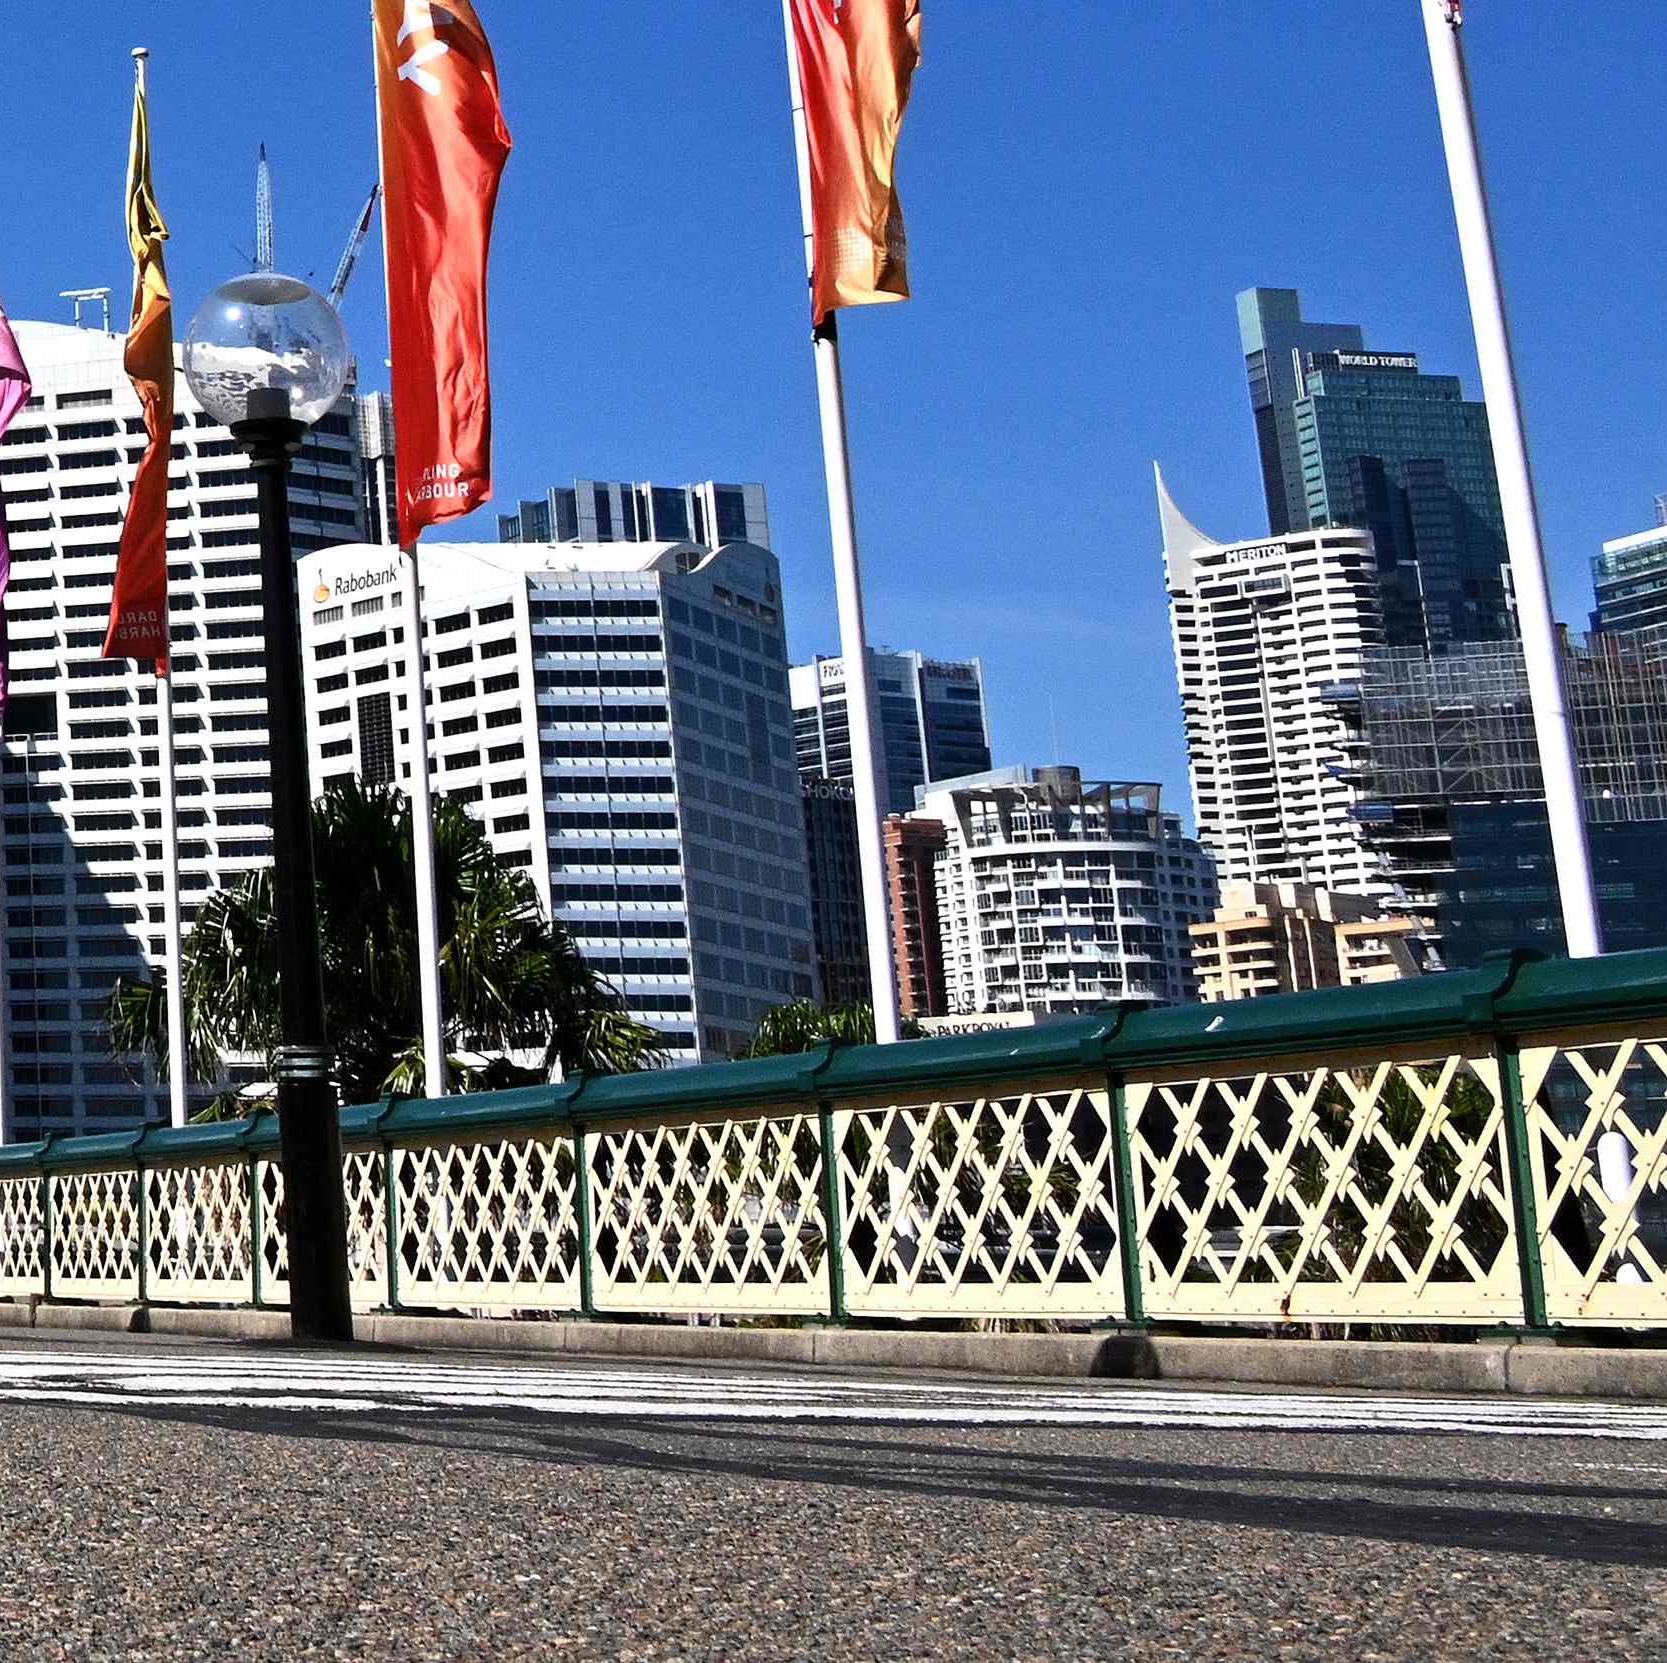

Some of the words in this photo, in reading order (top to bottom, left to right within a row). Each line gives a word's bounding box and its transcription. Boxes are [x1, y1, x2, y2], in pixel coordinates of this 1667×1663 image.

[1339, 354, 1378, 366] WORLD
[1378, 356, 1419, 368] TOWER
[1225, 543, 1287, 564] MERITON
[334, 562, 397, 597] Rabobank
